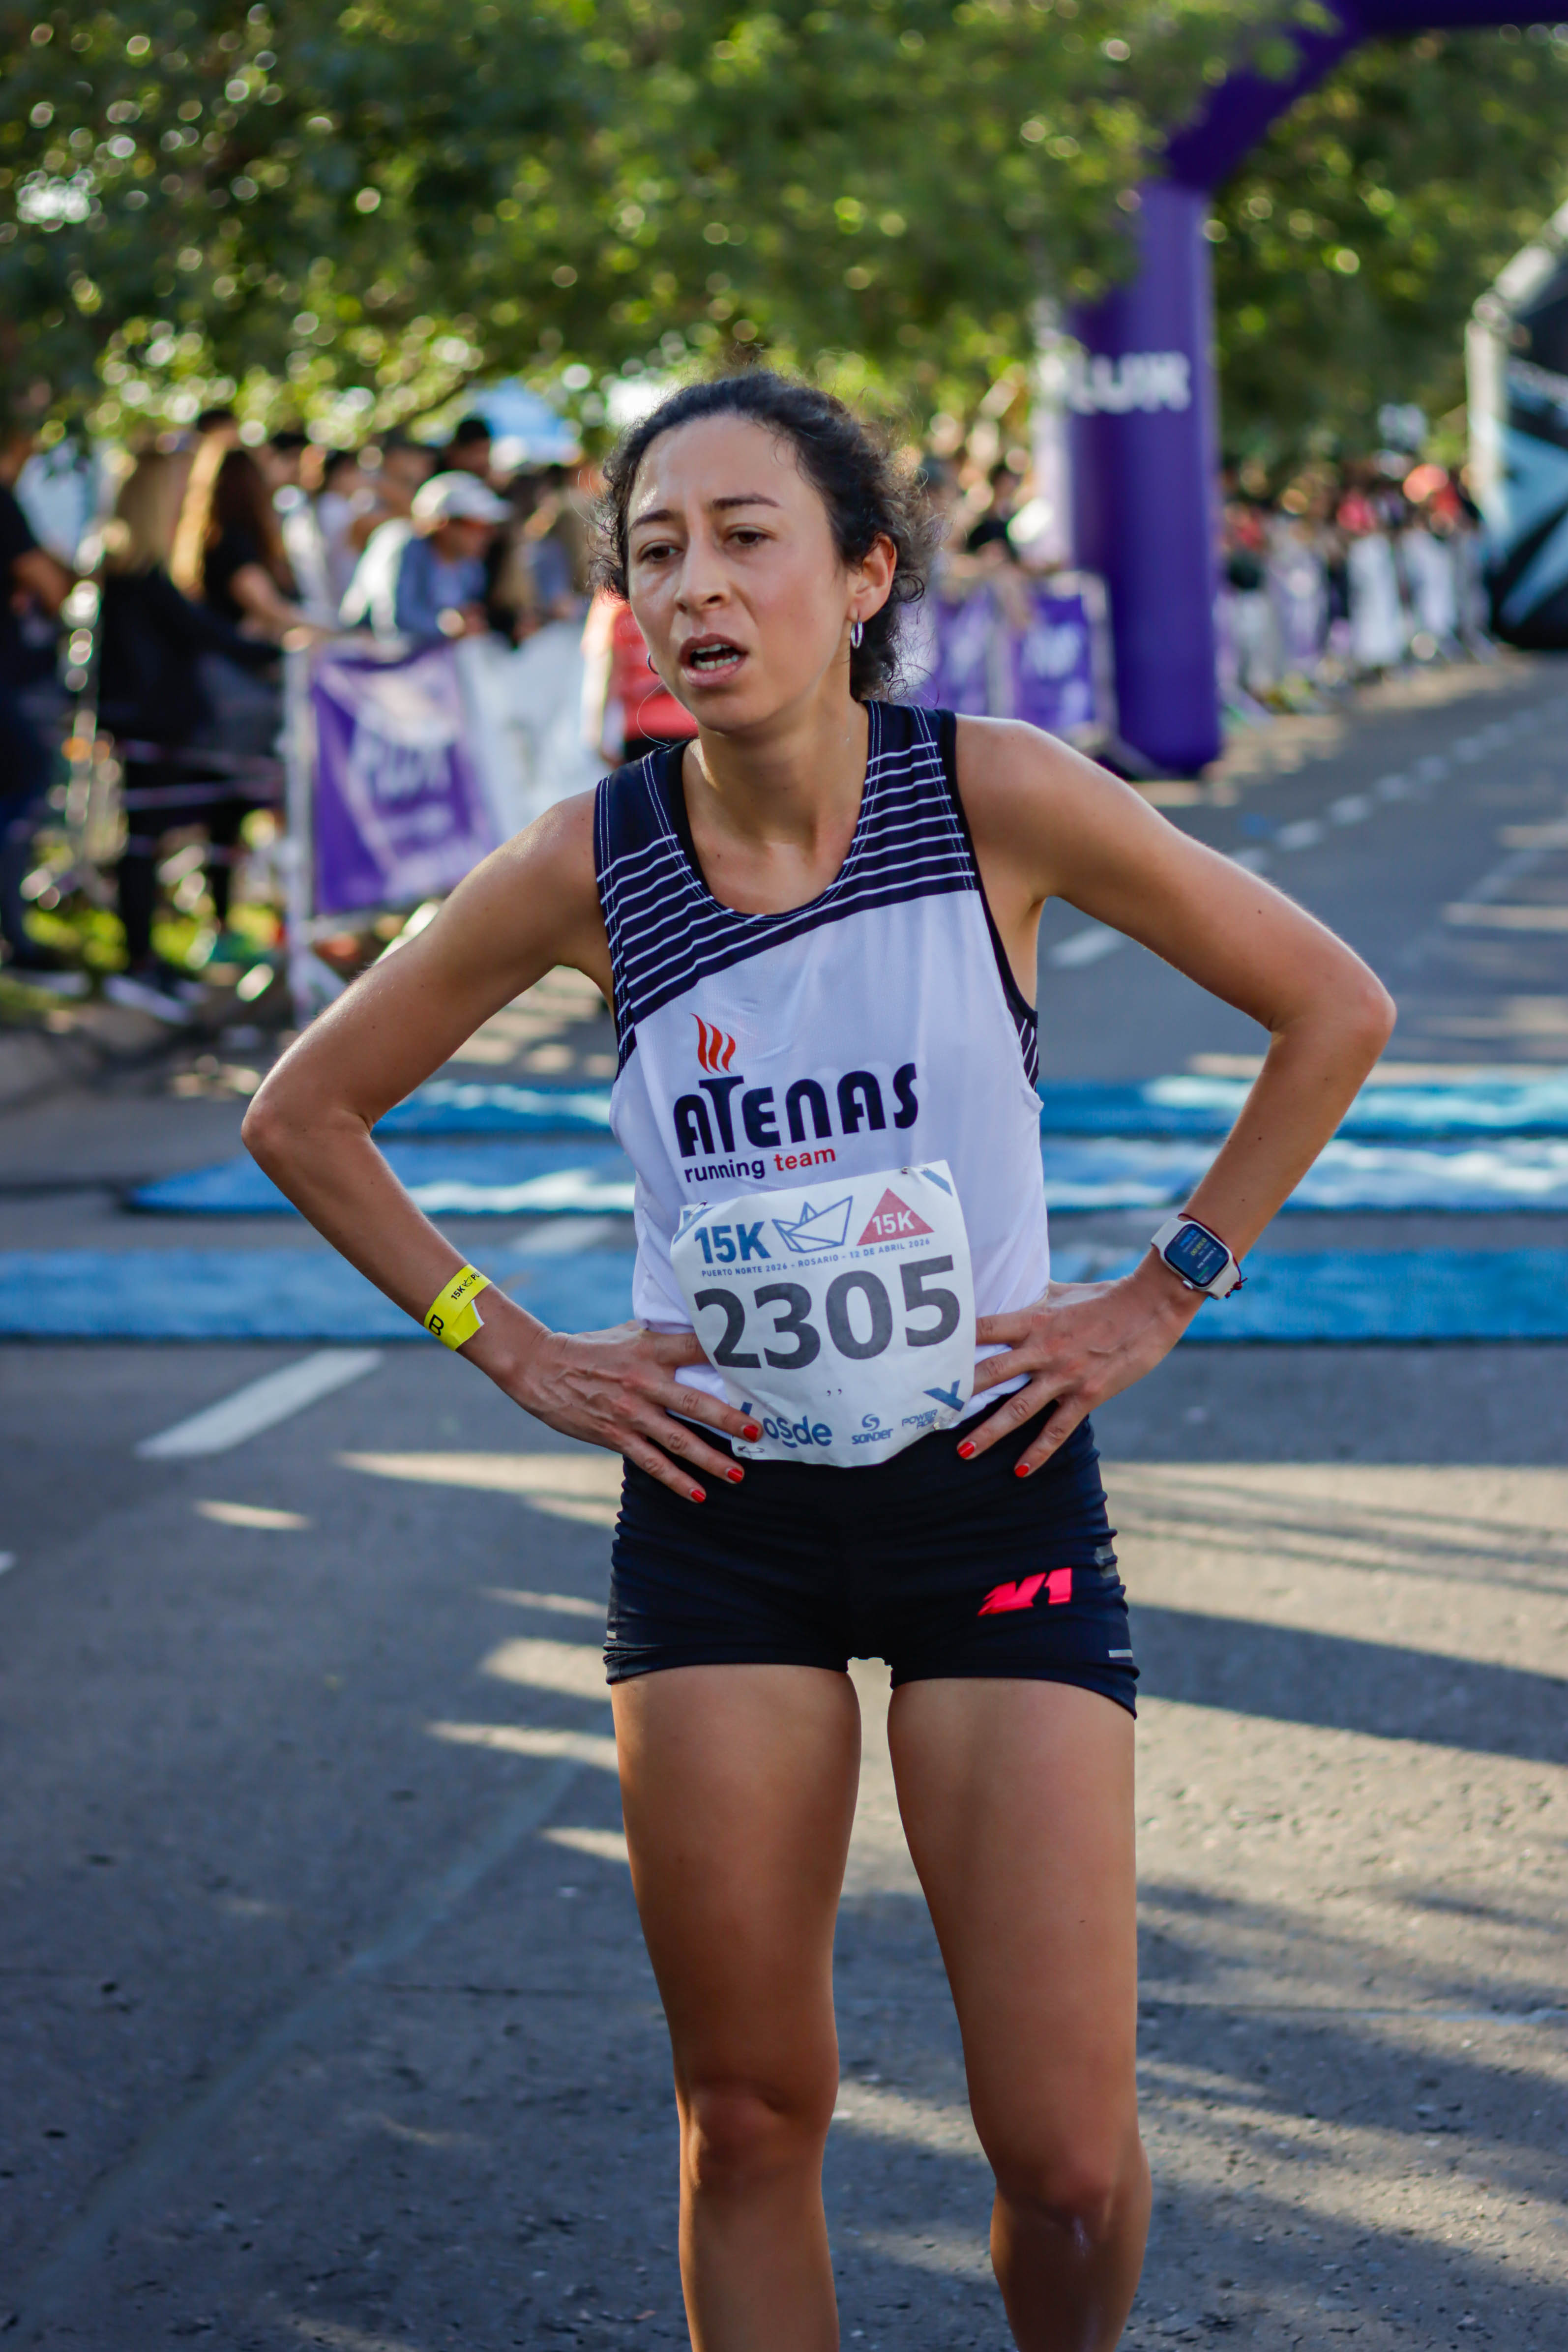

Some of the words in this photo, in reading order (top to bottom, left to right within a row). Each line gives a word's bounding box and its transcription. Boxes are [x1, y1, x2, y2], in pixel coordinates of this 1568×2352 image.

[673, 1062, 918, 1158] ATENAS
[684, 1158, 766, 1183] running
[773, 1148, 836, 1172] team
[872, 1210, 915, 1235] 15K
[694, 1221, 771, 1264] 15K
[701, 1268, 733, 1277] PUERTO
[735, 1265, 763, 1275] NORTE
[766, 1263, 788, 1272] 2026
[798, 1255, 839, 1267] ROSARIO
[863, 1248, 875, 1257] DE
[878, 1242, 905, 1254] ABRIL
[909, 1238, 930, 1248] 2026
[451, 1285, 466, 1300] 15K
[693, 1254, 961, 1370] 2305
[763, 1414, 832, 1446] osde
